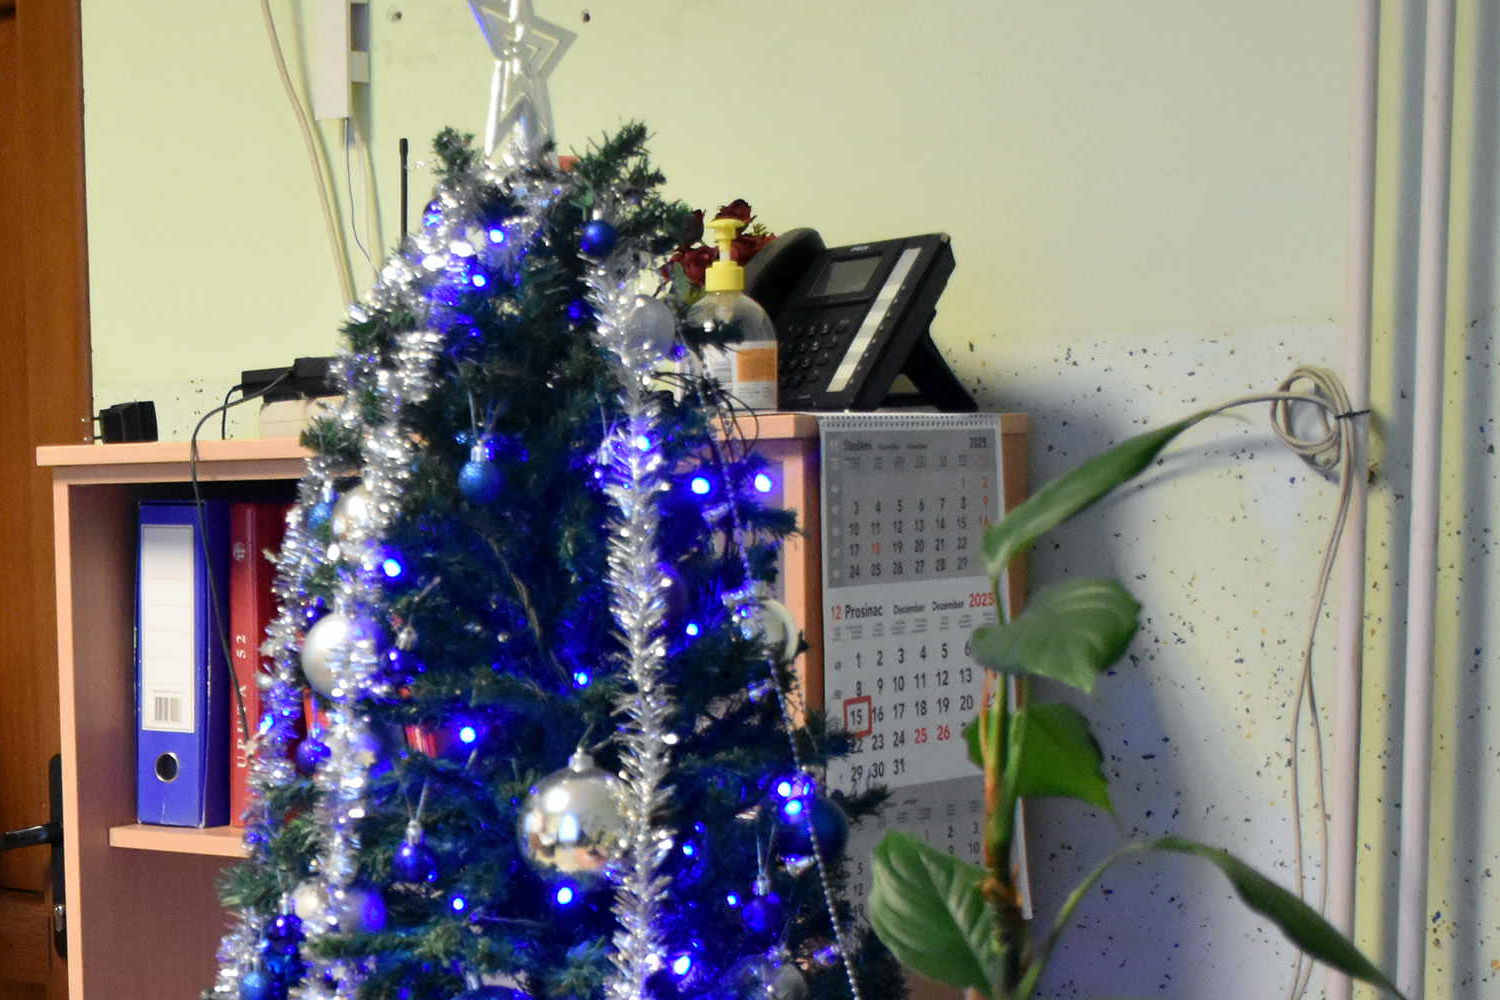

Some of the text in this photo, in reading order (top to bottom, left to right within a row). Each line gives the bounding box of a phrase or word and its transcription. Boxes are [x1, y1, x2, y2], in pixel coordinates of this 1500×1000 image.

[853, 501, 859, 514] 3
[874, 501, 881, 514] 4
[897, 500, 903, 513] 5
[939, 497, 946, 510] 7
[850, 523, 860, 536] 10
[871, 521, 880, 534] 11
[893, 520, 903, 533] 12
[914, 519, 924, 532] 13
[935, 517, 945, 530] 14
[957, 516, 967, 530] 15
[850, 543, 860, 557] 17
[893, 541, 903, 554] 19
[914, 540, 924, 553] 20
[935, 538, 945, 551] 21
[957, 537, 967, 550] 22
[850, 565, 860, 579] 24
[871, 563, 881, 577] 25
[892, 562, 903, 575] 26
[914, 560, 925, 574] 27
[935, 558, 945, 572] 28
[957, 556, 967, 570] 29
[831, 592, 995, 620] 12 Prosinac December Dezember 2025
[856, 652, 861, 669] 1
[877, 650, 883, 666] 2
[898, 647, 904, 664] 3
[920, 645, 927, 661] 4
[941, 643, 948, 659] 5
[856, 681, 862, 697] 8
[877, 678, 883, 695] 9
[893, 675, 904, 692] 10
[914, 672, 926, 689] 11
[936, 670, 948, 686] 12
[959, 668, 972, 684] 13
[850, 709, 862, 726] 15
[872, 706, 884, 723] 16
[893, 703, 904, 720] 17
[914, 700, 927, 717] 18
[936, 697, 949, 714] 19
[959, 694, 973, 711] 20
[871, 734, 884, 751] 23
[892, 730, 905, 747] 24
[914, 727, 927, 744] 25
[937, 724, 950, 741] 26
[851, 765, 863, 781] 29
[872, 761, 884, 779] 30
[893, 758, 904, 775] 31
[947, 825, 953, 839] 2
[972, 821, 979, 834] 3
[968, 841, 980, 854] 10
[853, 883, 863, 896] 12
